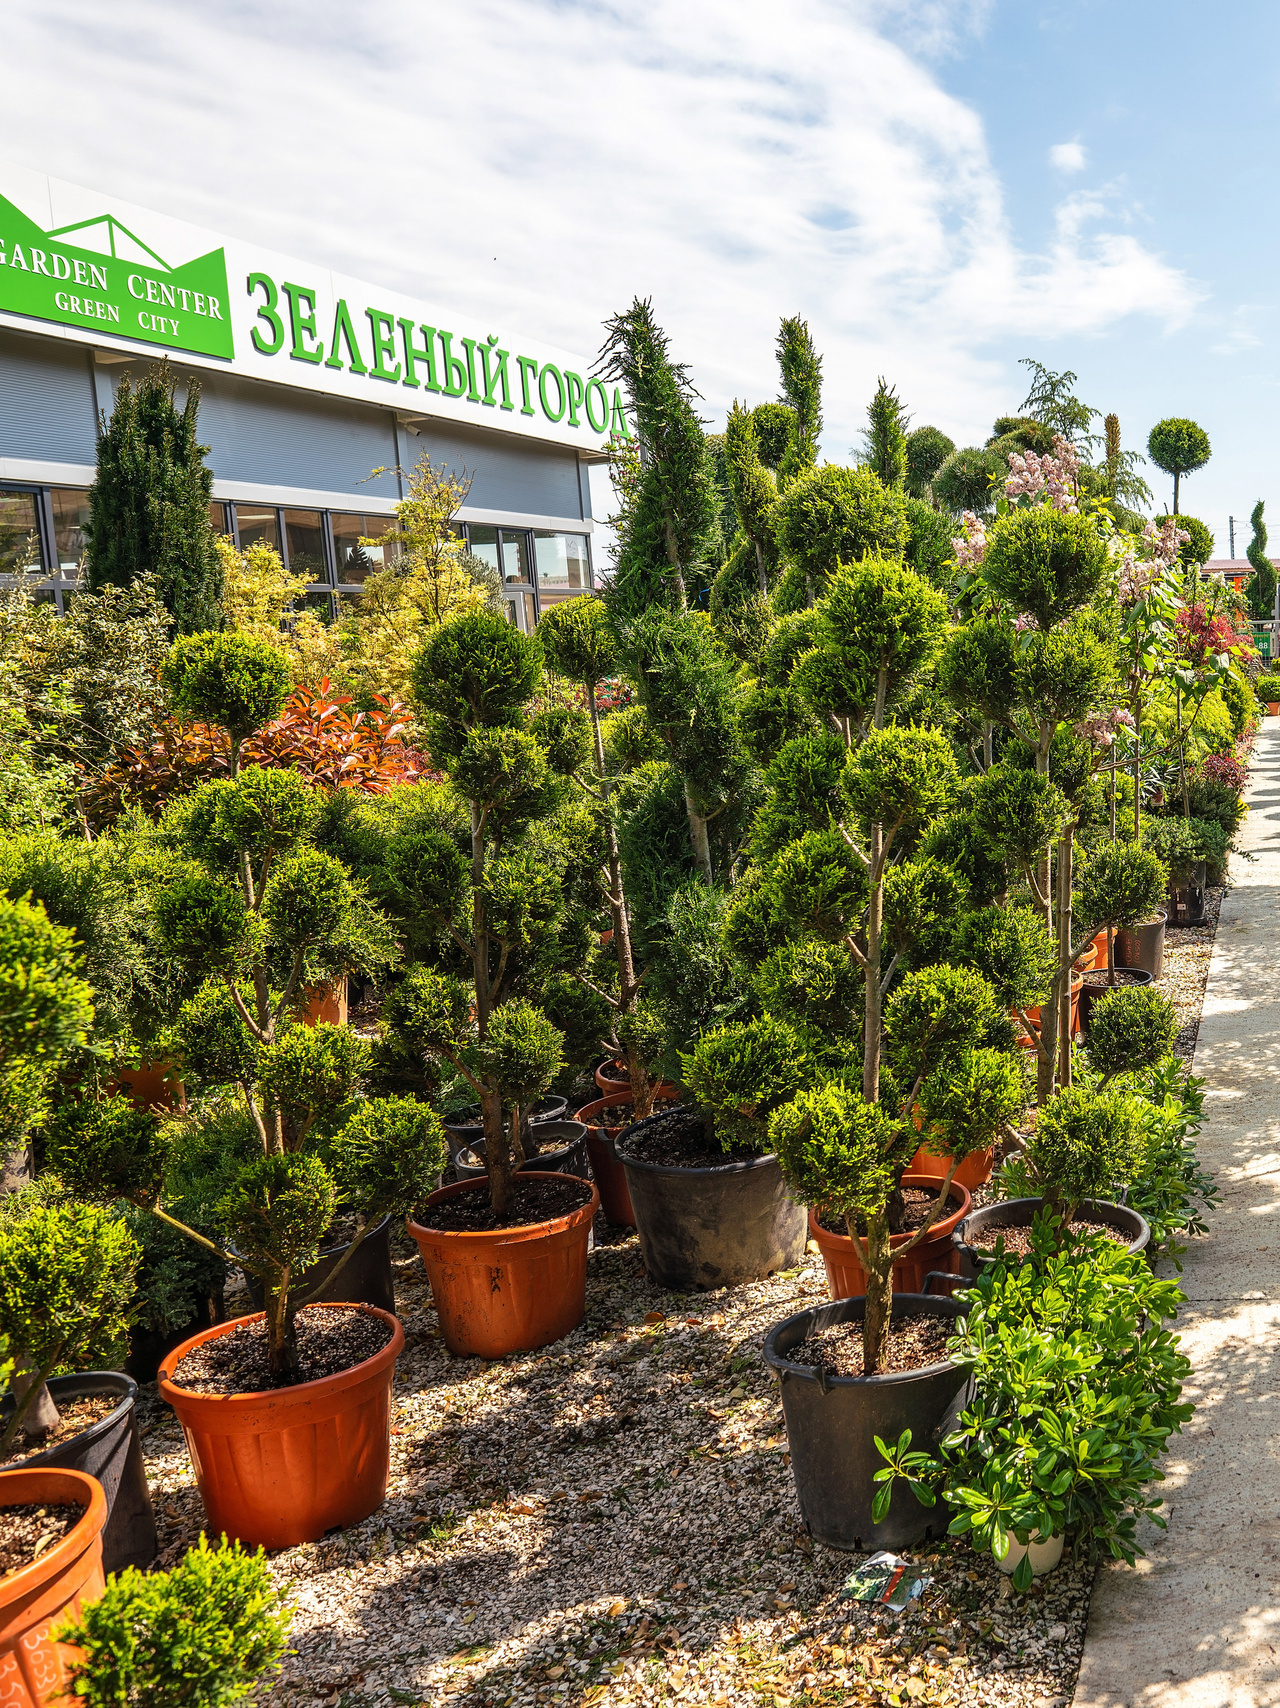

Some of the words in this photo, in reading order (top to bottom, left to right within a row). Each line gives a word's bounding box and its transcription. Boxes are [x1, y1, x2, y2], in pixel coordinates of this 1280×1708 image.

[54, 291, 120, 324] GREEN
[137, 311, 180, 338] CITY
[127, 274, 224, 321] CENTER
[246, 272, 515, 413] ЗЕЛЕНЫЙ
[516, 355, 631, 448] ГОРОД
